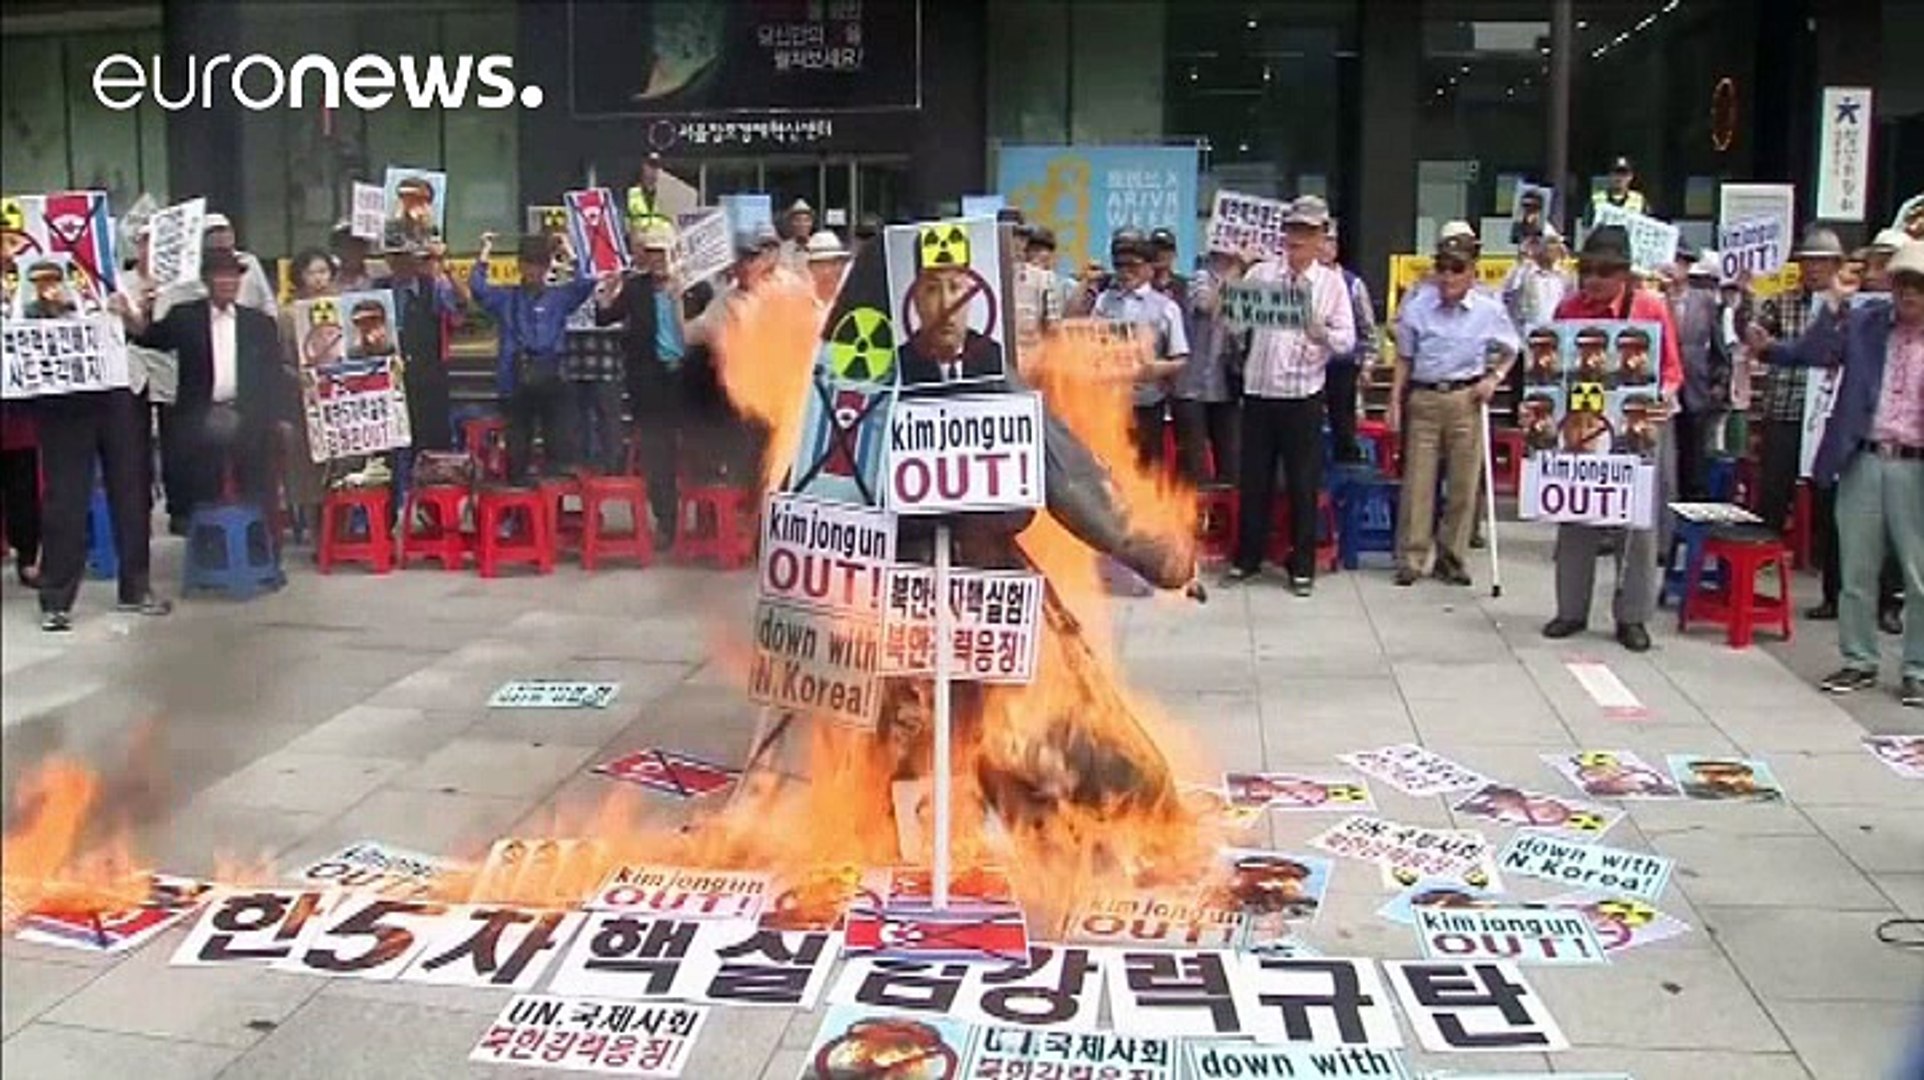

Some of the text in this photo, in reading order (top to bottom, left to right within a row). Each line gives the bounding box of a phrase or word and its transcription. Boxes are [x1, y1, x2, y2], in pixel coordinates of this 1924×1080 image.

[894, 452, 1029, 504] OUT!
[1541, 483, 1629, 519] OUT!
[768, 547, 882, 609] OUT!
[759, 606, 878, 673] down with
[1516, 835, 1661, 877] down with
[602, 883, 751, 918] OUT!
[1431, 931, 1592, 959] OUT!
[1202, 1047, 1392, 1078] down with
